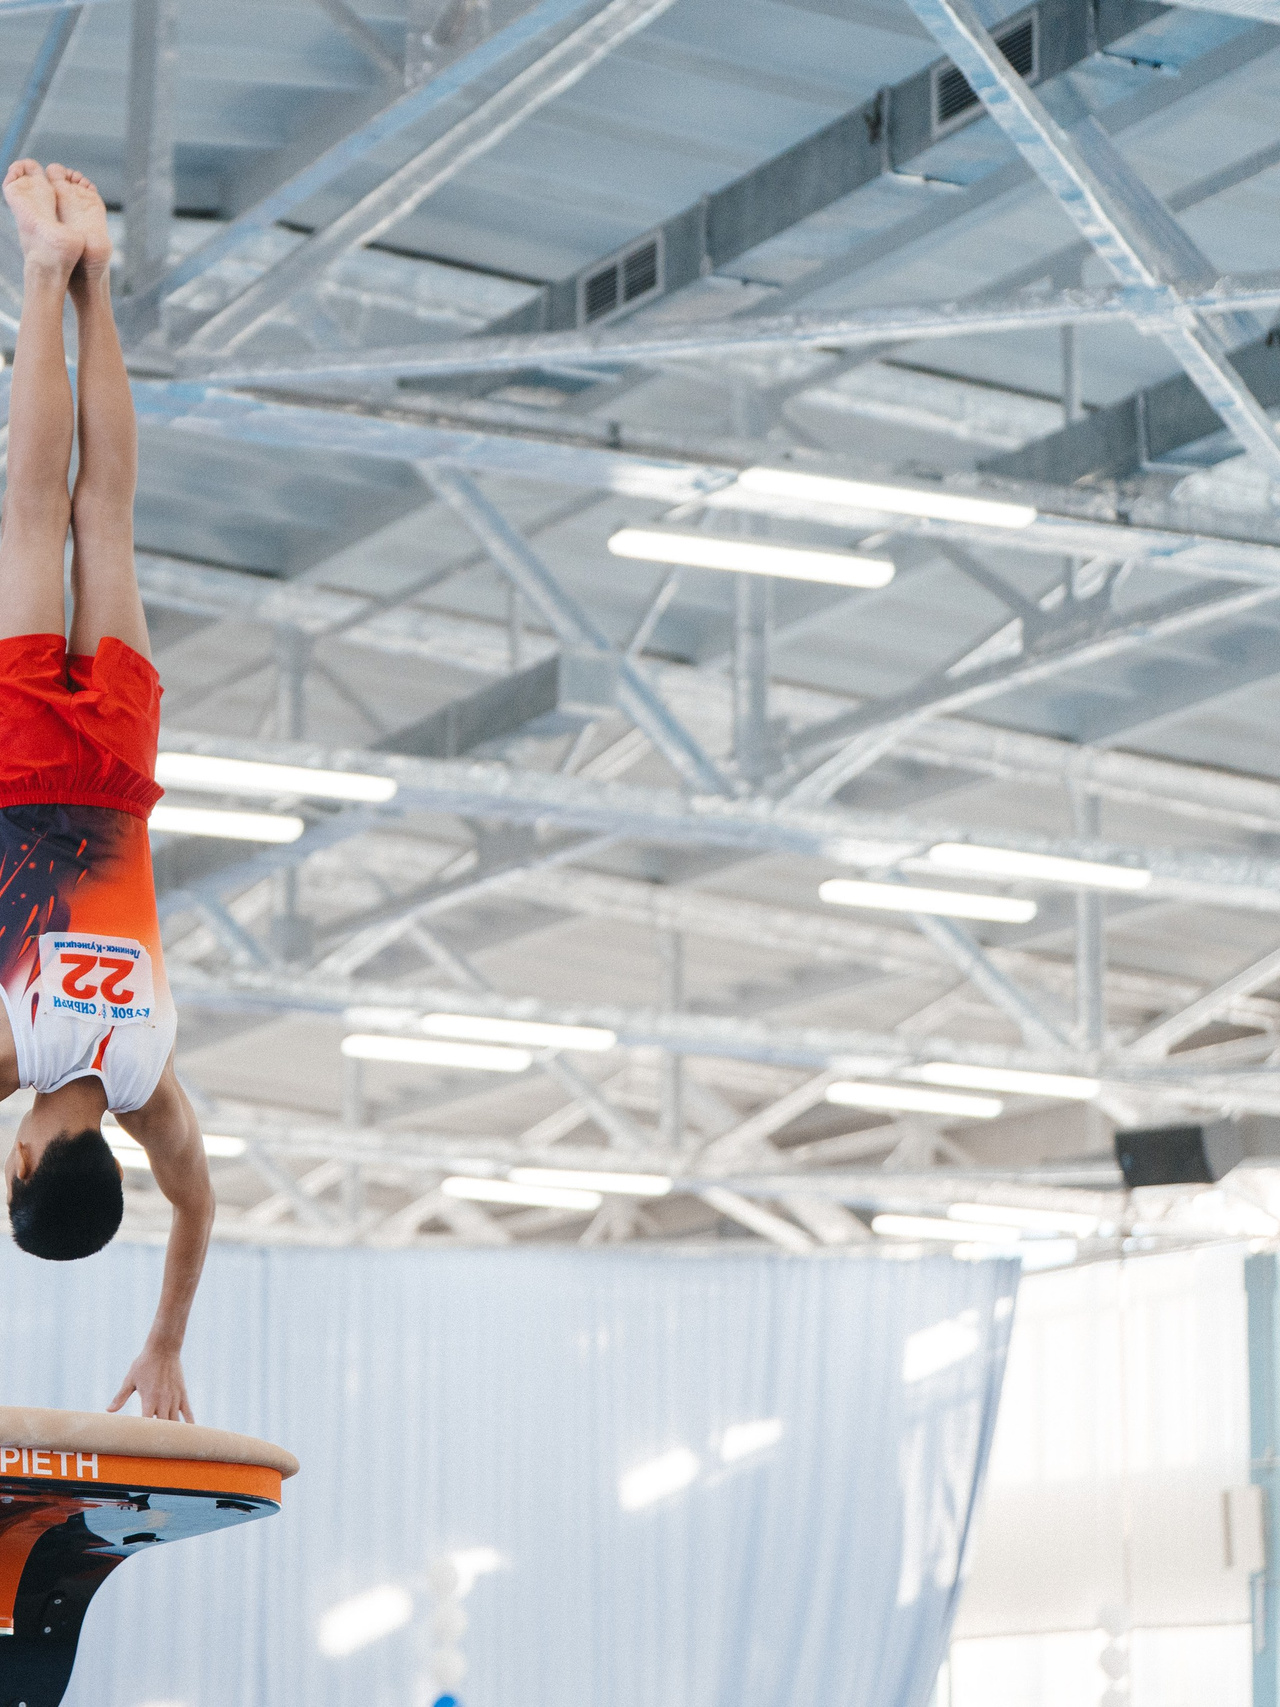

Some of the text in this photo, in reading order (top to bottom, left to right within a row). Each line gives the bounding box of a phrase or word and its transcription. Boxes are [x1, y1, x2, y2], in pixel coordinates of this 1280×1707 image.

[54, 941, 141, 959] Ленинск-Кузнецкий
[60, 953, 135, 1005] 22
[53, 995, 150, 1019] КУБОК СИБИРИ
